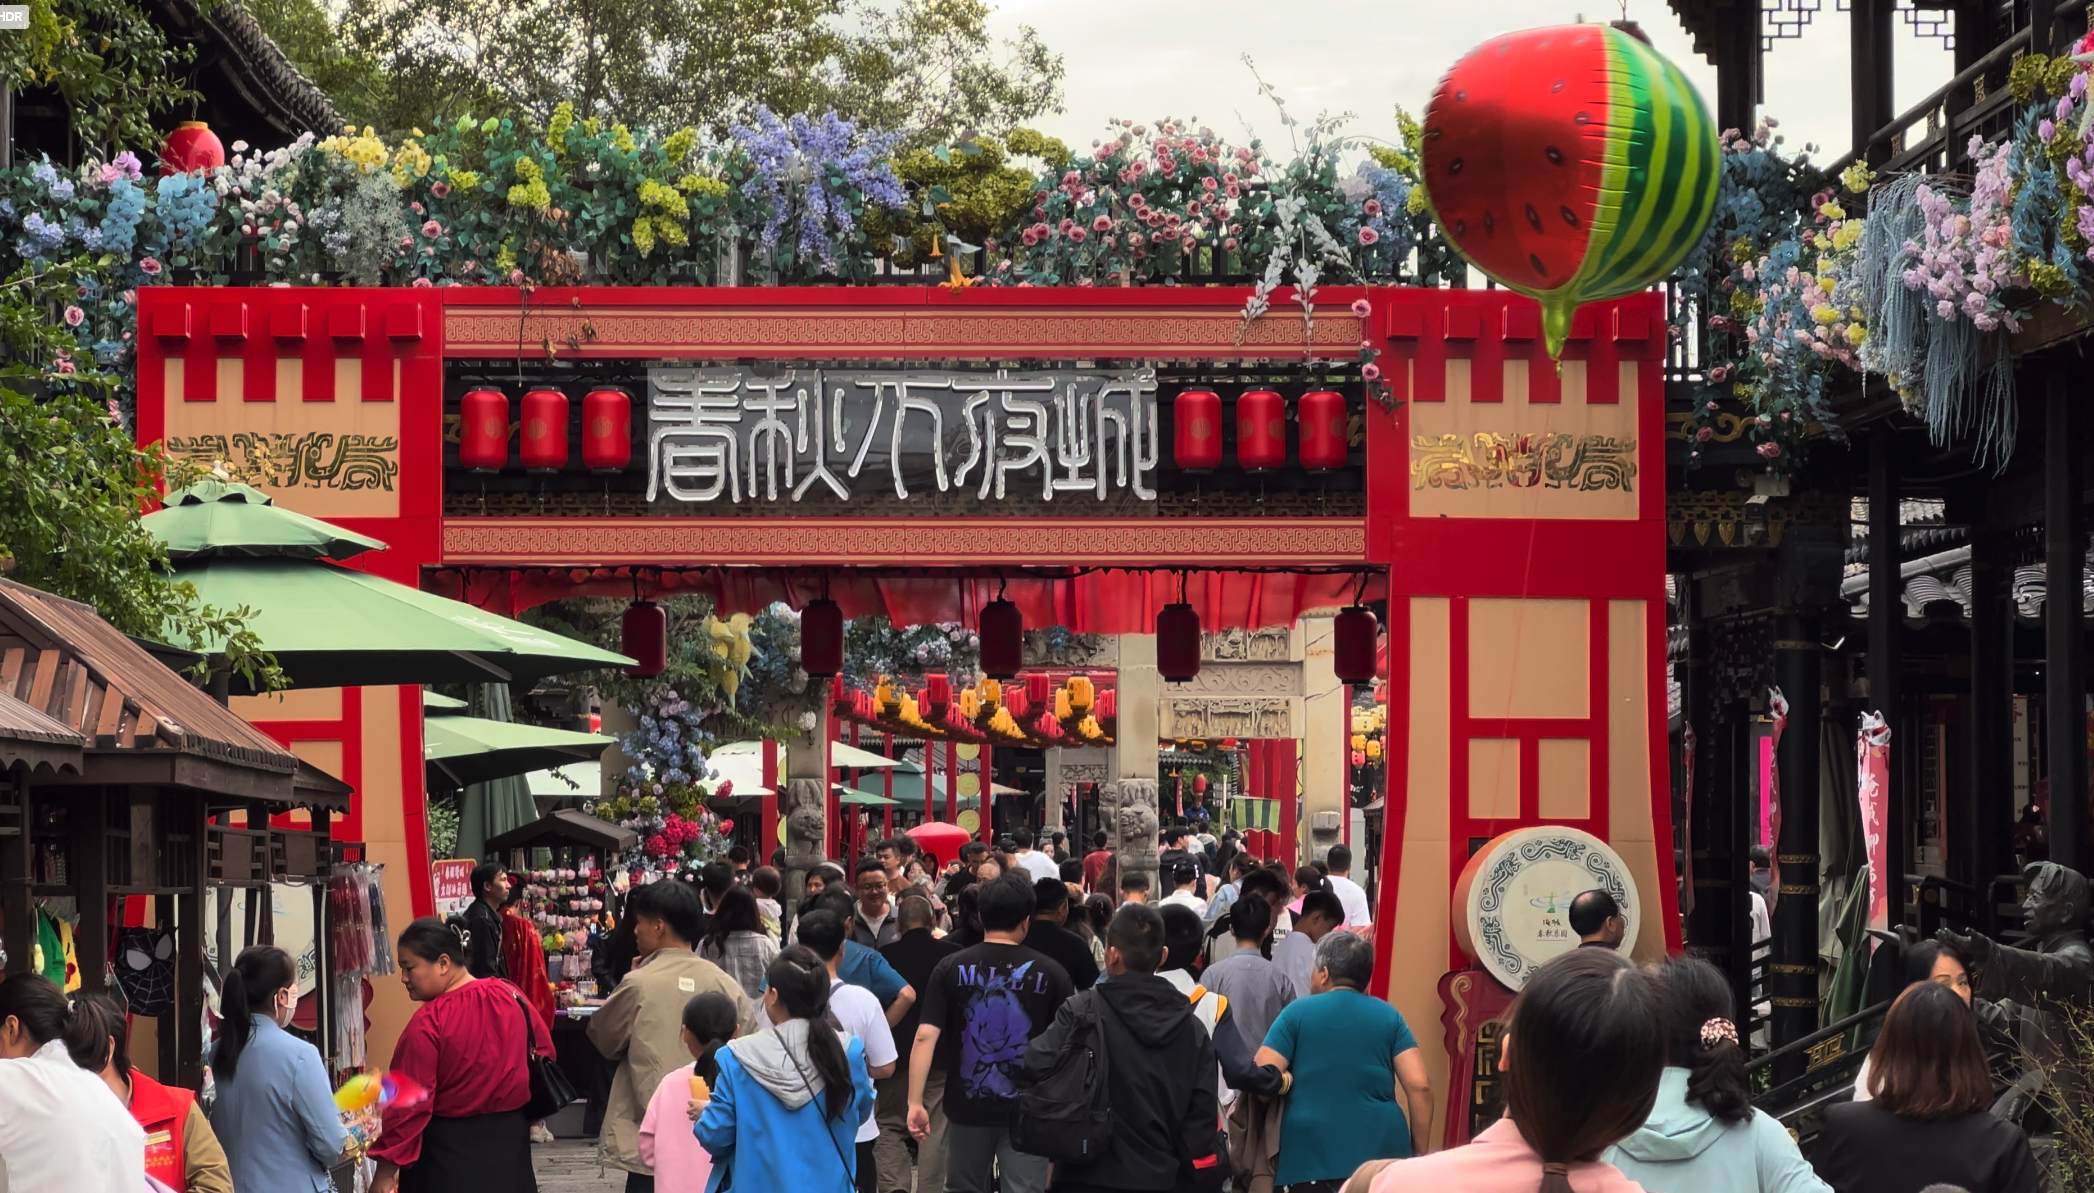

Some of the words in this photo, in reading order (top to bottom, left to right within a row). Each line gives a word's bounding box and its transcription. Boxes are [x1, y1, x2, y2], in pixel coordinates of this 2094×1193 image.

[646, 368, 1158, 501] 春秋不夜城
